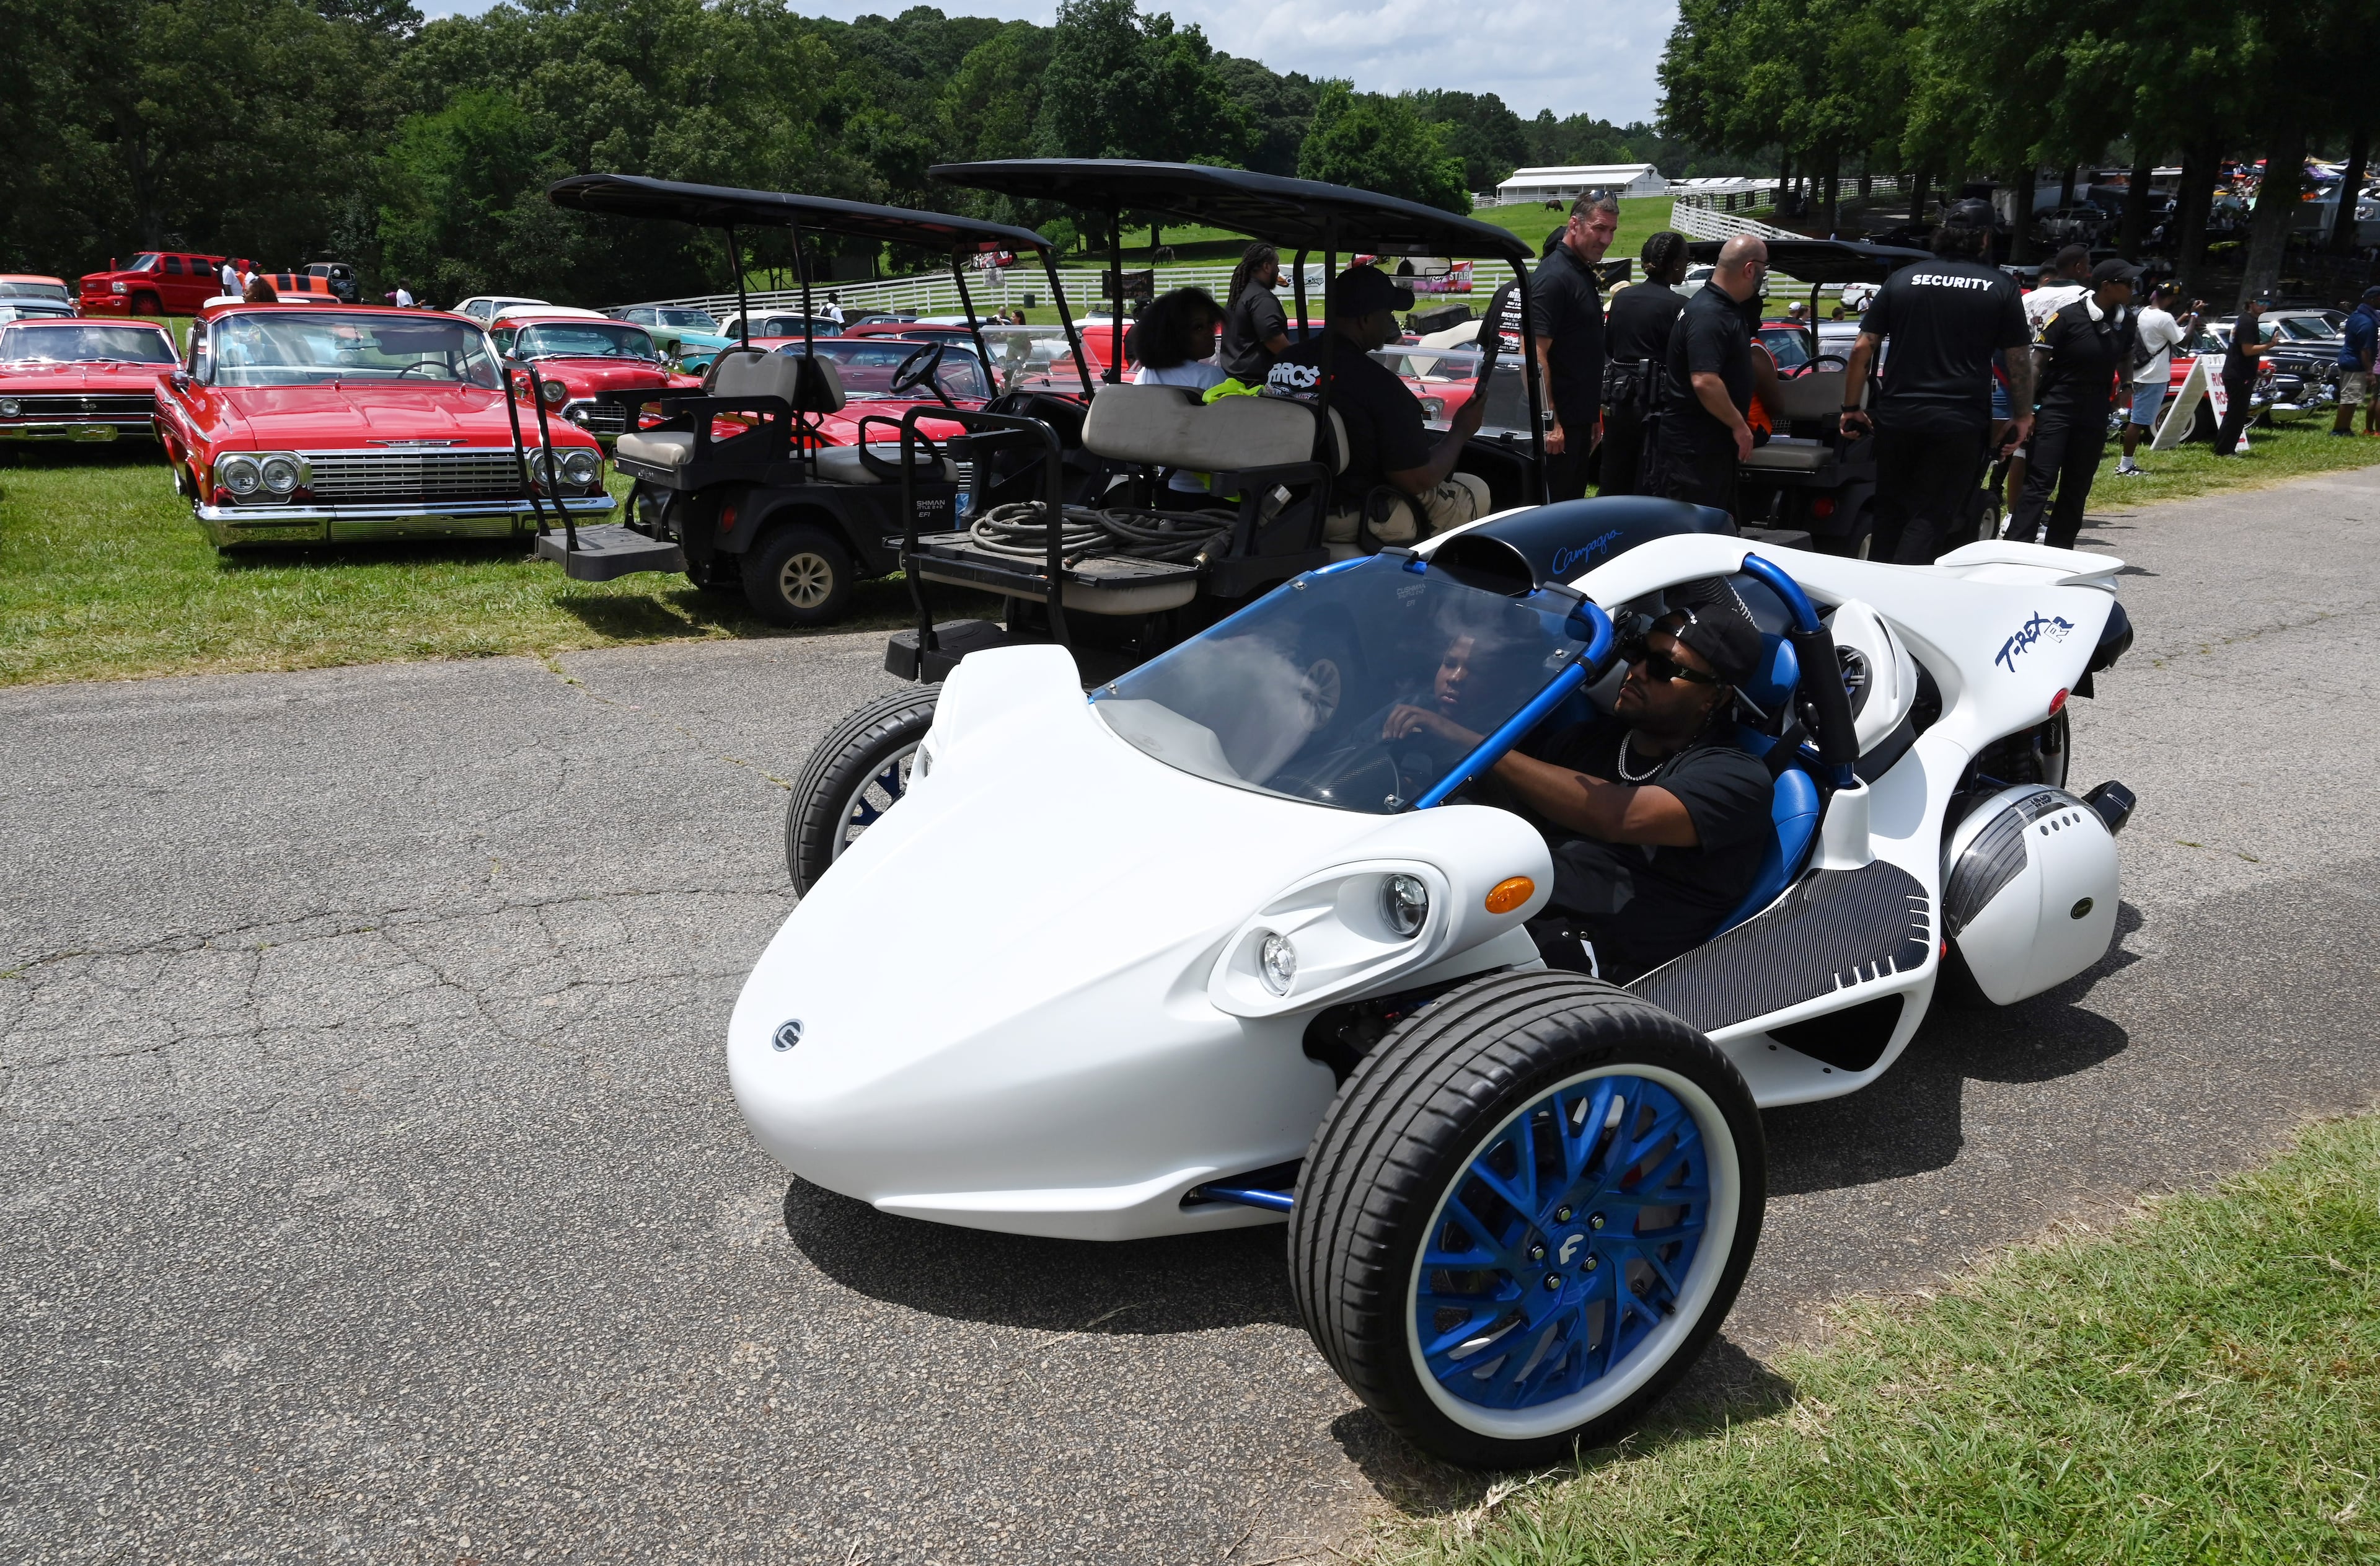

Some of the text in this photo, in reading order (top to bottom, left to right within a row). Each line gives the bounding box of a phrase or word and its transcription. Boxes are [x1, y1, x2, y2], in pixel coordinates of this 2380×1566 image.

[1911, 274, 1994, 291] SECURITY
[2211, 373, 2225, 386] RIC
[2214, 391, 2229, 405] ROS
[1552, 529, 1624, 575] Campagna
